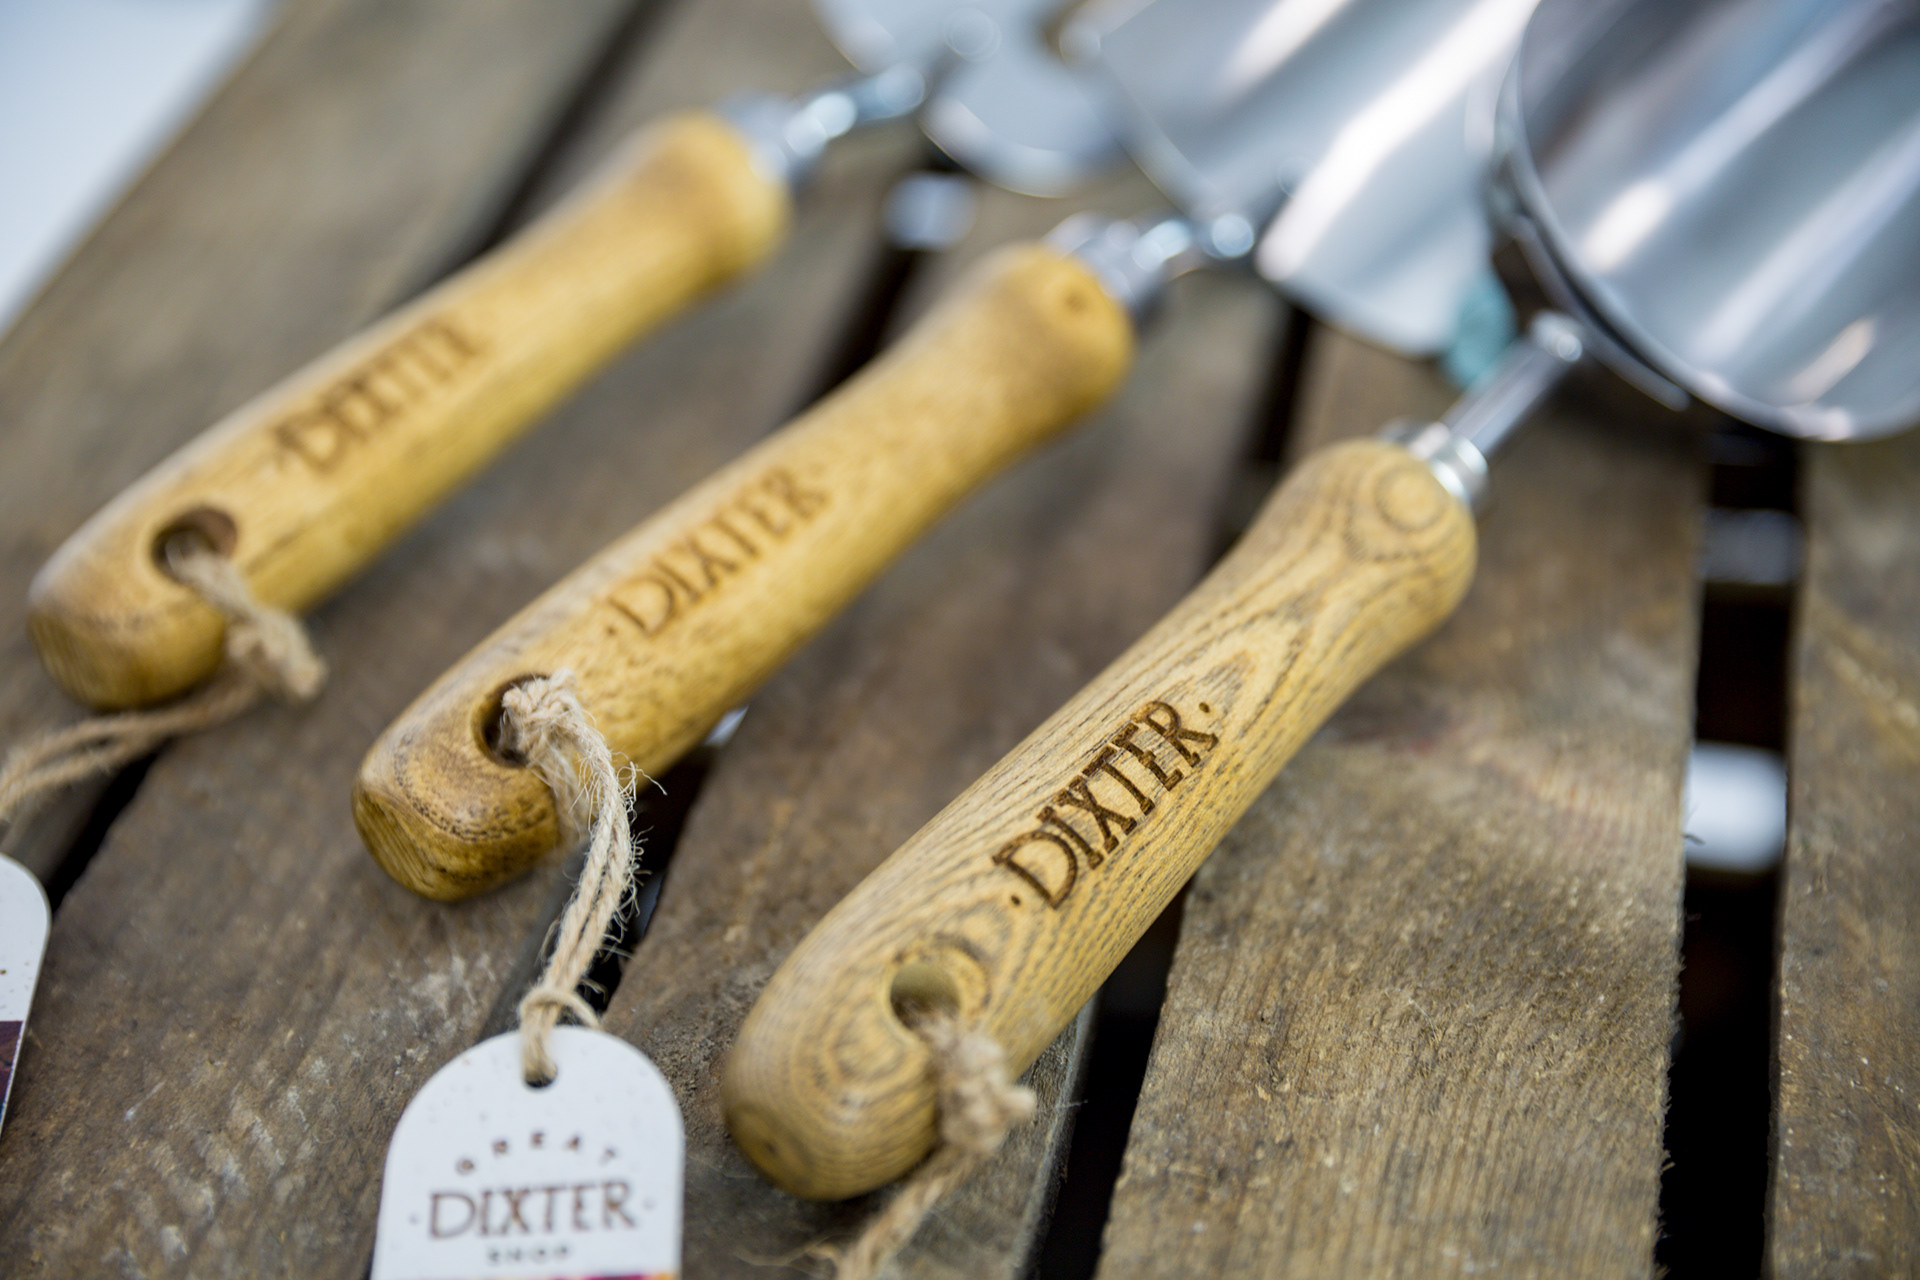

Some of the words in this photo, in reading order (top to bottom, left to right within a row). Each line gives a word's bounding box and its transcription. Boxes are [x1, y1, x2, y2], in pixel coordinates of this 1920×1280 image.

[608, 467, 832, 638] DIXTER
[992, 701, 1219, 910] DIXTER
[429, 1181, 637, 1239] DIXTER
